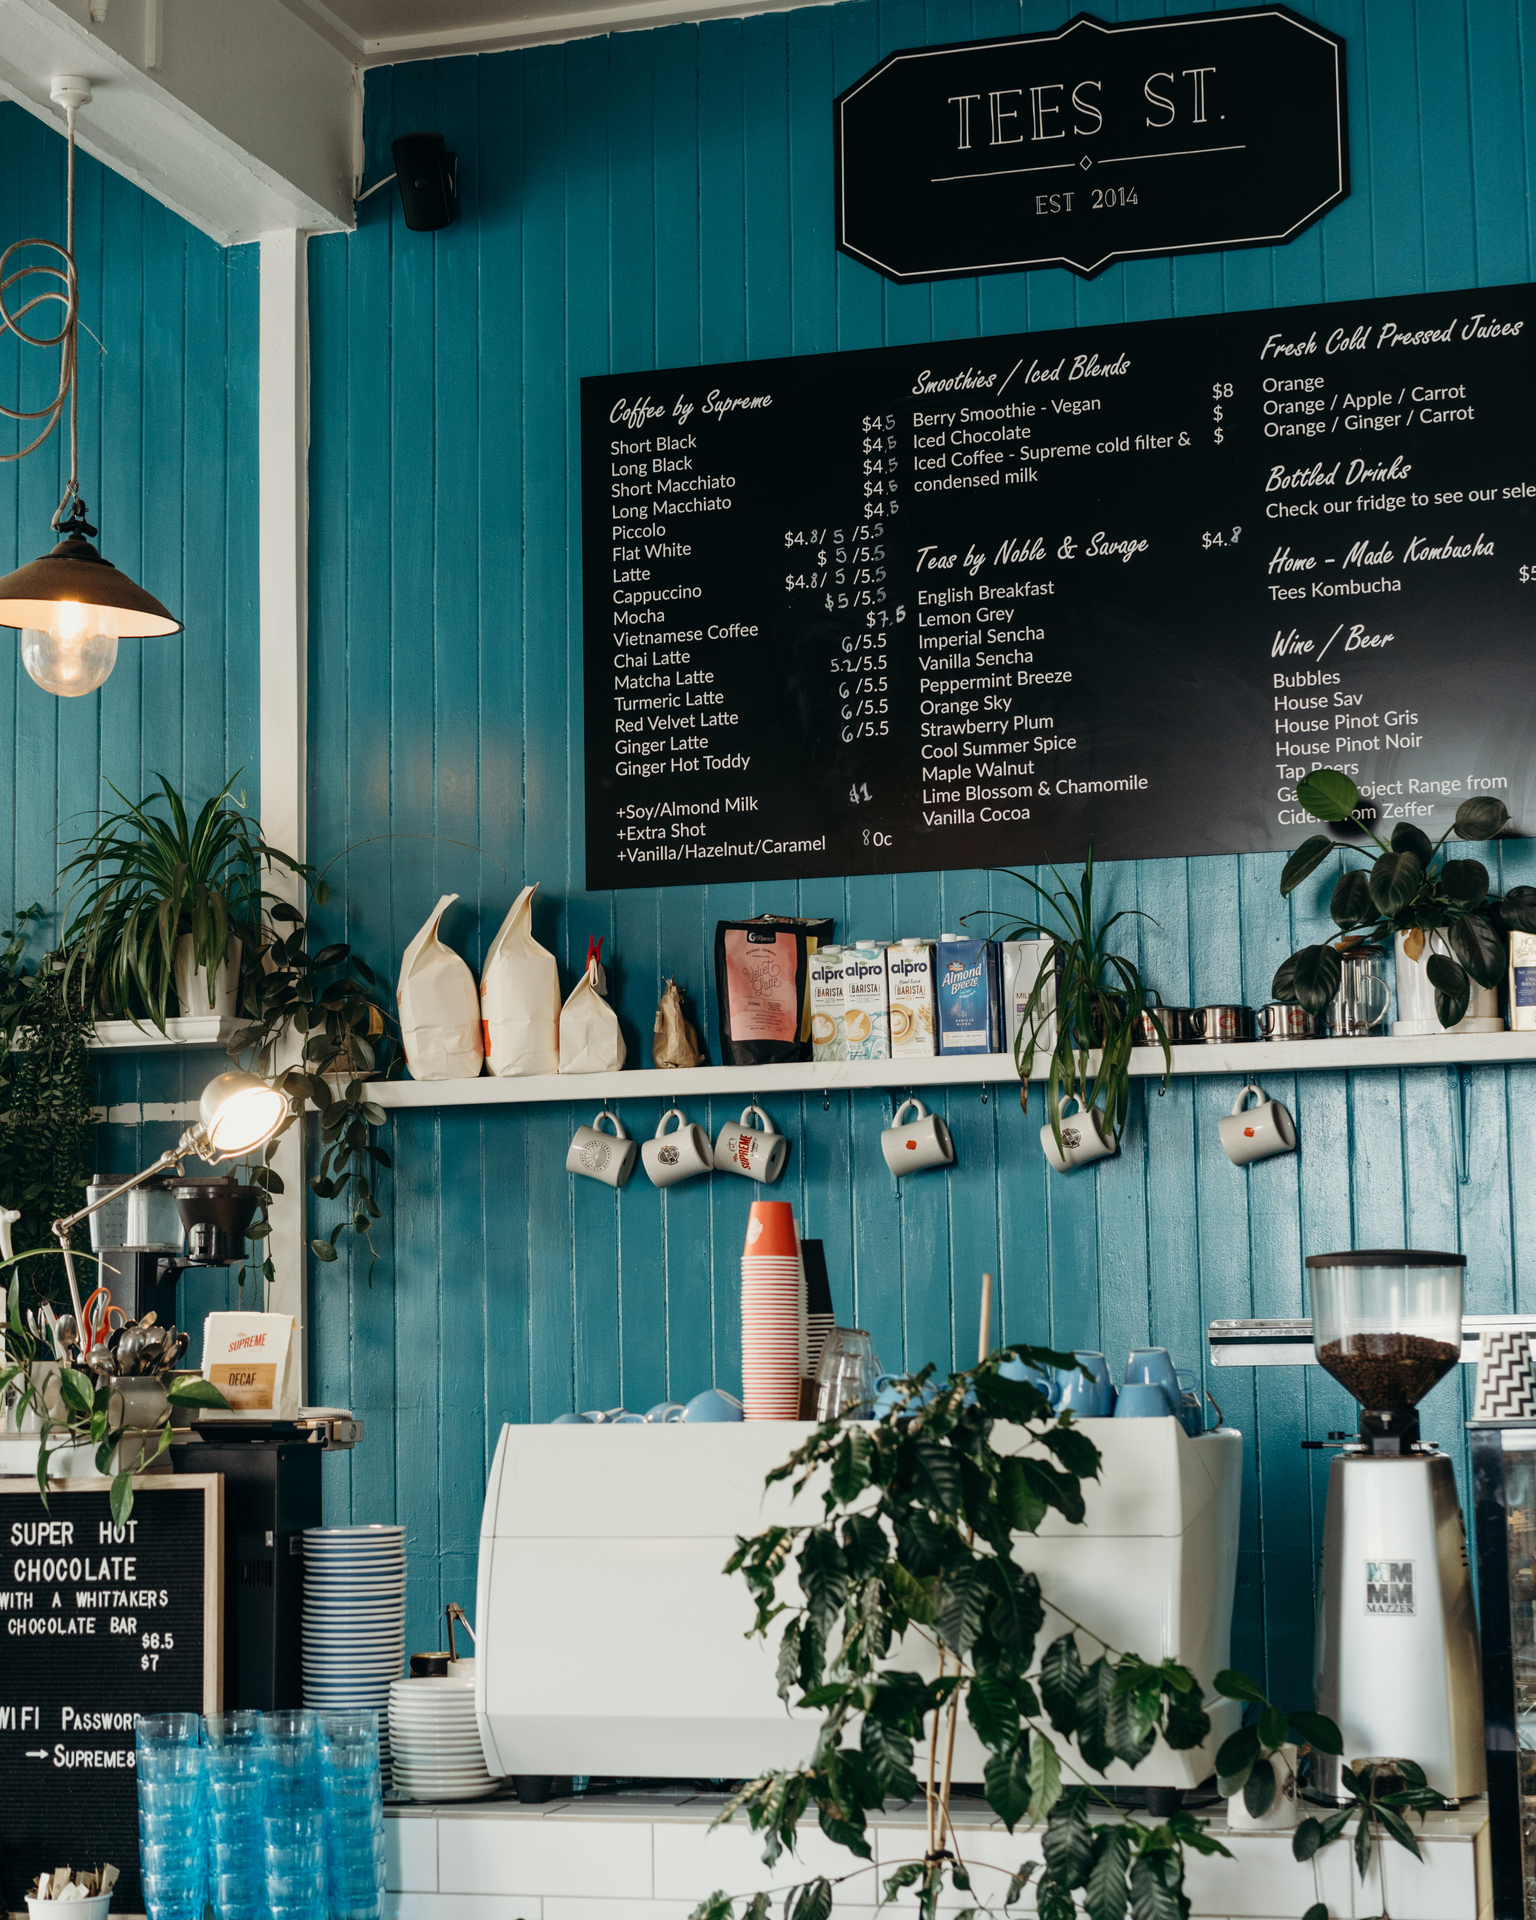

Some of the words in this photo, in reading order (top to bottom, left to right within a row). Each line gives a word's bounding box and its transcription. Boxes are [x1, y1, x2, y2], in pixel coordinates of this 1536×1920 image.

[947, 80, 1103, 150] TEES
[1144, 66, 1226, 128] ST.
[1035, 192, 1075, 215] EST
[1091, 186, 1139, 210] 2014
[1260, 331, 1317, 360] Fresh
[1325, 326, 1372, 355] Cold
[1377, 319, 1457, 349] Pressed
[1460, 314, 1524, 340] Juices
[912, 367, 997, 394] Smoothies
[1025, 358, 1065, 384] Iced
[1068, 353, 1131, 381] Blends
[1212, 382, 1234, 401] $8
[1263, 377, 1324, 393] Orange
[610, 396, 665, 429] Coffee
[672, 394, 694, 425] by
[702, 389, 772, 421] Supreme
[1263, 400, 1325, 415] Orange
[1343, 391, 1392, 411] Apple
[1412, 384, 1466, 402] Carrot
[913, 413, 956, 427] Berry
[960, 403, 1035, 422] Smoothie
[1051, 399, 1100, 415] Vegan
[1264, 422, 1326, 437] Orange
[1345, 415, 1401, 431] Ginger
[1420, 406, 1475, 423] Carrot
[611, 439, 651, 455] Short
[657, 434, 697, 451] Black
[914, 431, 945, 449] Iced
[951, 426, 1031, 445] Chocolate
[914, 453, 946, 470] Iced
[951, 450, 1003, 466] Coffee
[1020, 444, 1091, 462] Supreme
[1096, 436, 1129, 453] cold
[1135, 434, 1173, 450] filter
[612, 463, 647, 477] Long
[653, 456, 692, 473] Black
[1265, 462, 1341, 492] Bottled
[1345, 455, 1412, 485] Drinks
[611, 482, 652, 498] Short
[657, 475, 735, 494] Macchiato
[914, 470, 999, 492] condensed
[1005, 467, 1038, 484] milk
[613, 505, 648, 520] Long
[653, 497, 731, 515] Macchiato
[1266, 500, 1318, 518] Check
[1323, 500, 1352, 514] our
[1356, 494, 1406, 513] fridge
[1411, 492, 1429, 506] to
[1434, 492, 1463, 504] see
[1468, 487, 1498, 502] our
[613, 523, 666, 540] Piccolo
[613, 547, 640, 561] Flat
[644, 543, 691, 558] White
[916, 545, 957, 572] Teas
[963, 544, 986, 576] by
[994, 537, 1046, 565] Noble
[1086, 531, 1149, 563] Savage
[1268, 547, 1317, 574] Home
[1342, 540, 1394, 569] Made
[1403, 533, 1494, 563] Kombucha
[613, 568, 650, 583] Latte
[613, 585, 702, 606] Cappuccino
[918, 587, 973, 607] English
[979, 581, 1054, 600] Breakfast
[1268, 585, 1306, 600] Tees
[1312, 577, 1401, 597] Kombucha
[614, 609, 664, 625] Mocha
[919, 613, 971, 627] Lemon
[976, 607, 1014, 623] Grey
[613, 630, 703, 647] Vietnamese
[708, 623, 758, 639] Coffee
[919, 630, 981, 651] Imperial
[987, 626, 1044, 643] Sencha
[1271, 628, 1315, 657] Wine
[1344, 624, 1395, 651] Beer
[614, 653, 647, 668] Chai
[653, 651, 690, 665] Latte
[919, 653, 970, 671] Vanilla
[976, 649, 1033, 666] Sencha
[615, 673, 670, 690] Matcha
[676, 670, 714, 685] Latte
[920, 673, 1012, 695] Peppermint
[1018, 671, 1072, 685] Breeze
[1274, 670, 1340, 688] Bubbles
[614, 693, 681, 711] Turmeric
[686, 691, 724, 706] Latte
[920, 700, 979, 715] Orange
[984, 695, 1012, 712] Sky
[1275, 696, 1328, 711] House
[1334, 692, 1363, 707] Sav
[616, 718, 645, 733] Red
[647, 714, 696, 731] Velvet
[701, 712, 738, 727] Latte
[921, 719, 1009, 737] Strawberry
[1014, 715, 1053, 730] Plum
[1275, 718, 1329, 734] House
[1335, 713, 1379, 729] Pinot
[1384, 711, 1418, 726] Gris
[921, 742, 957, 759] Cool
[963, 741, 1029, 756] Summer
[1034, 735, 1076, 754] Spice
[1276, 741, 1330, 756] House
[1336, 736, 1380, 752] Pinot
[1386, 733, 1423, 749] Noir
[616, 761, 666, 777] Ginger
[671, 757, 699, 772] Hot
[703, 753, 750, 770] Toddy
[923, 764, 971, 783] Maple
[975, 760, 1034, 777] Walnut
[1276, 764, 1306, 781] Tap
[923, 788, 960, 804] Lime
[966, 785, 1032, 801] Blossom
[1056, 775, 1148, 794] Chamomile
[1409, 779, 1461, 795] Range
[1466, 775, 1507, 790] from
[616, 798, 719, 821] +Soy/Almond
[725, 796, 758, 812] Milk
[922, 809, 974, 826] Vanilla
[980, 807, 1030, 822] Cocoa
[1382, 801, 1434, 818] Zeffer
[617, 826, 666, 841] +Extra
[671, 823, 706, 838] Shot
[617, 835, 825, 862] +Vanilla/Hazelnut/Caramel
[845, 962, 883, 979] alpro
[891, 959, 927, 977] alpro
[941, 963, 982, 987] Almond
[817, 987, 843, 998] BARISTA
[851, 984, 878, 994] BARISTA
[897, 985, 923, 995] BARISTA
[951, 977, 979, 995] Breeze
[738, 1133, 752, 1170] SUPREME
[228, 1333, 267, 1353] SUPREME
[228, 1372, 256, 1387] DECAF
[10, 1521, 74, 1547] SUPER
[99, 1519, 138, 1545] HOT
[13, 1557, 137, 1582] CHOCOLATE
[0, 1591, 33, 1610] WITH
[51, 1591, 62, 1608] A
[76, 1589, 169, 1609] WHITTAKERS
[1366, 1604, 1414, 1613] MAZZER
[8, 1617, 96, 1636] CHOCOLATE
[110, 1616, 137, 1635] BAR
[141, 1632, 174, 1649] $6.5
[141, 1653, 159, 1672] $7
[0, 1706, 39, 1731] WIFI
